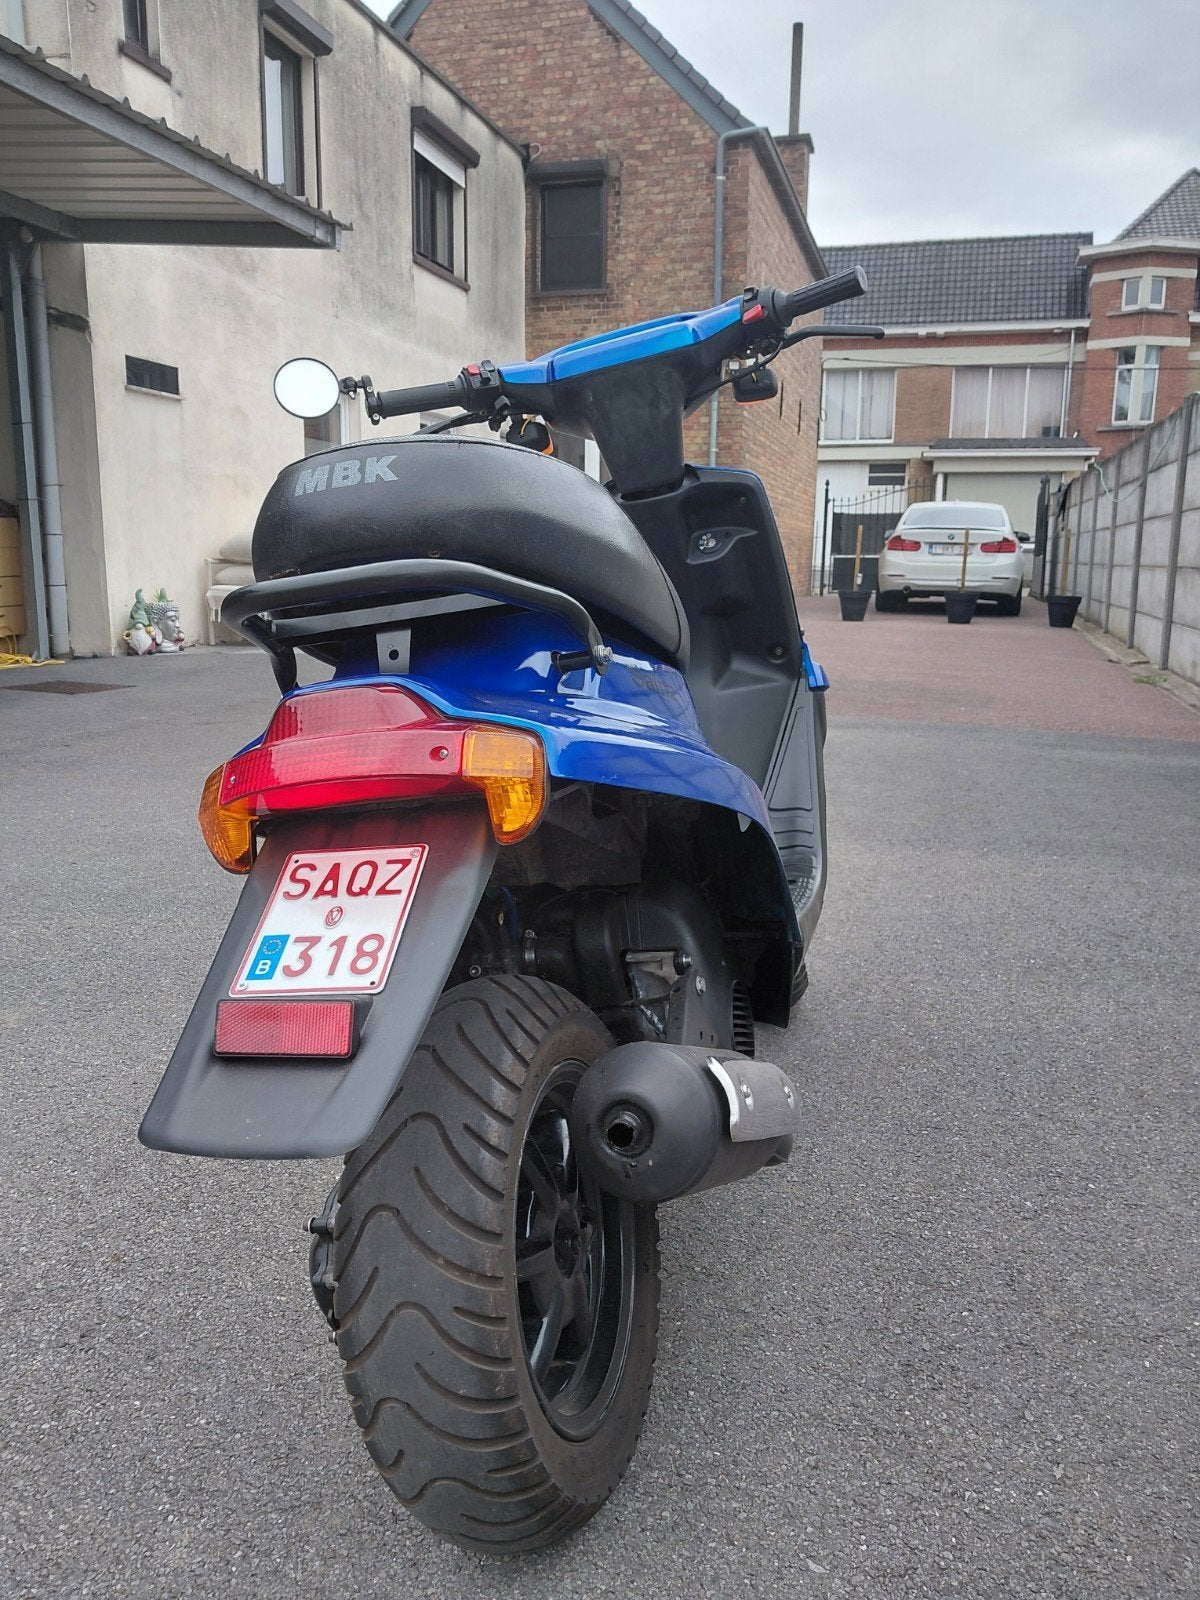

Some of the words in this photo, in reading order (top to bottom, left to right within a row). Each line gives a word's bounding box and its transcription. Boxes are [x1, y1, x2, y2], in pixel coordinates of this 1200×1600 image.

[295, 455, 399, 496] MBK
[282, 859, 412, 900] SAQZ
[255, 959, 272, 975] B
[282, 933, 385, 977] 318
